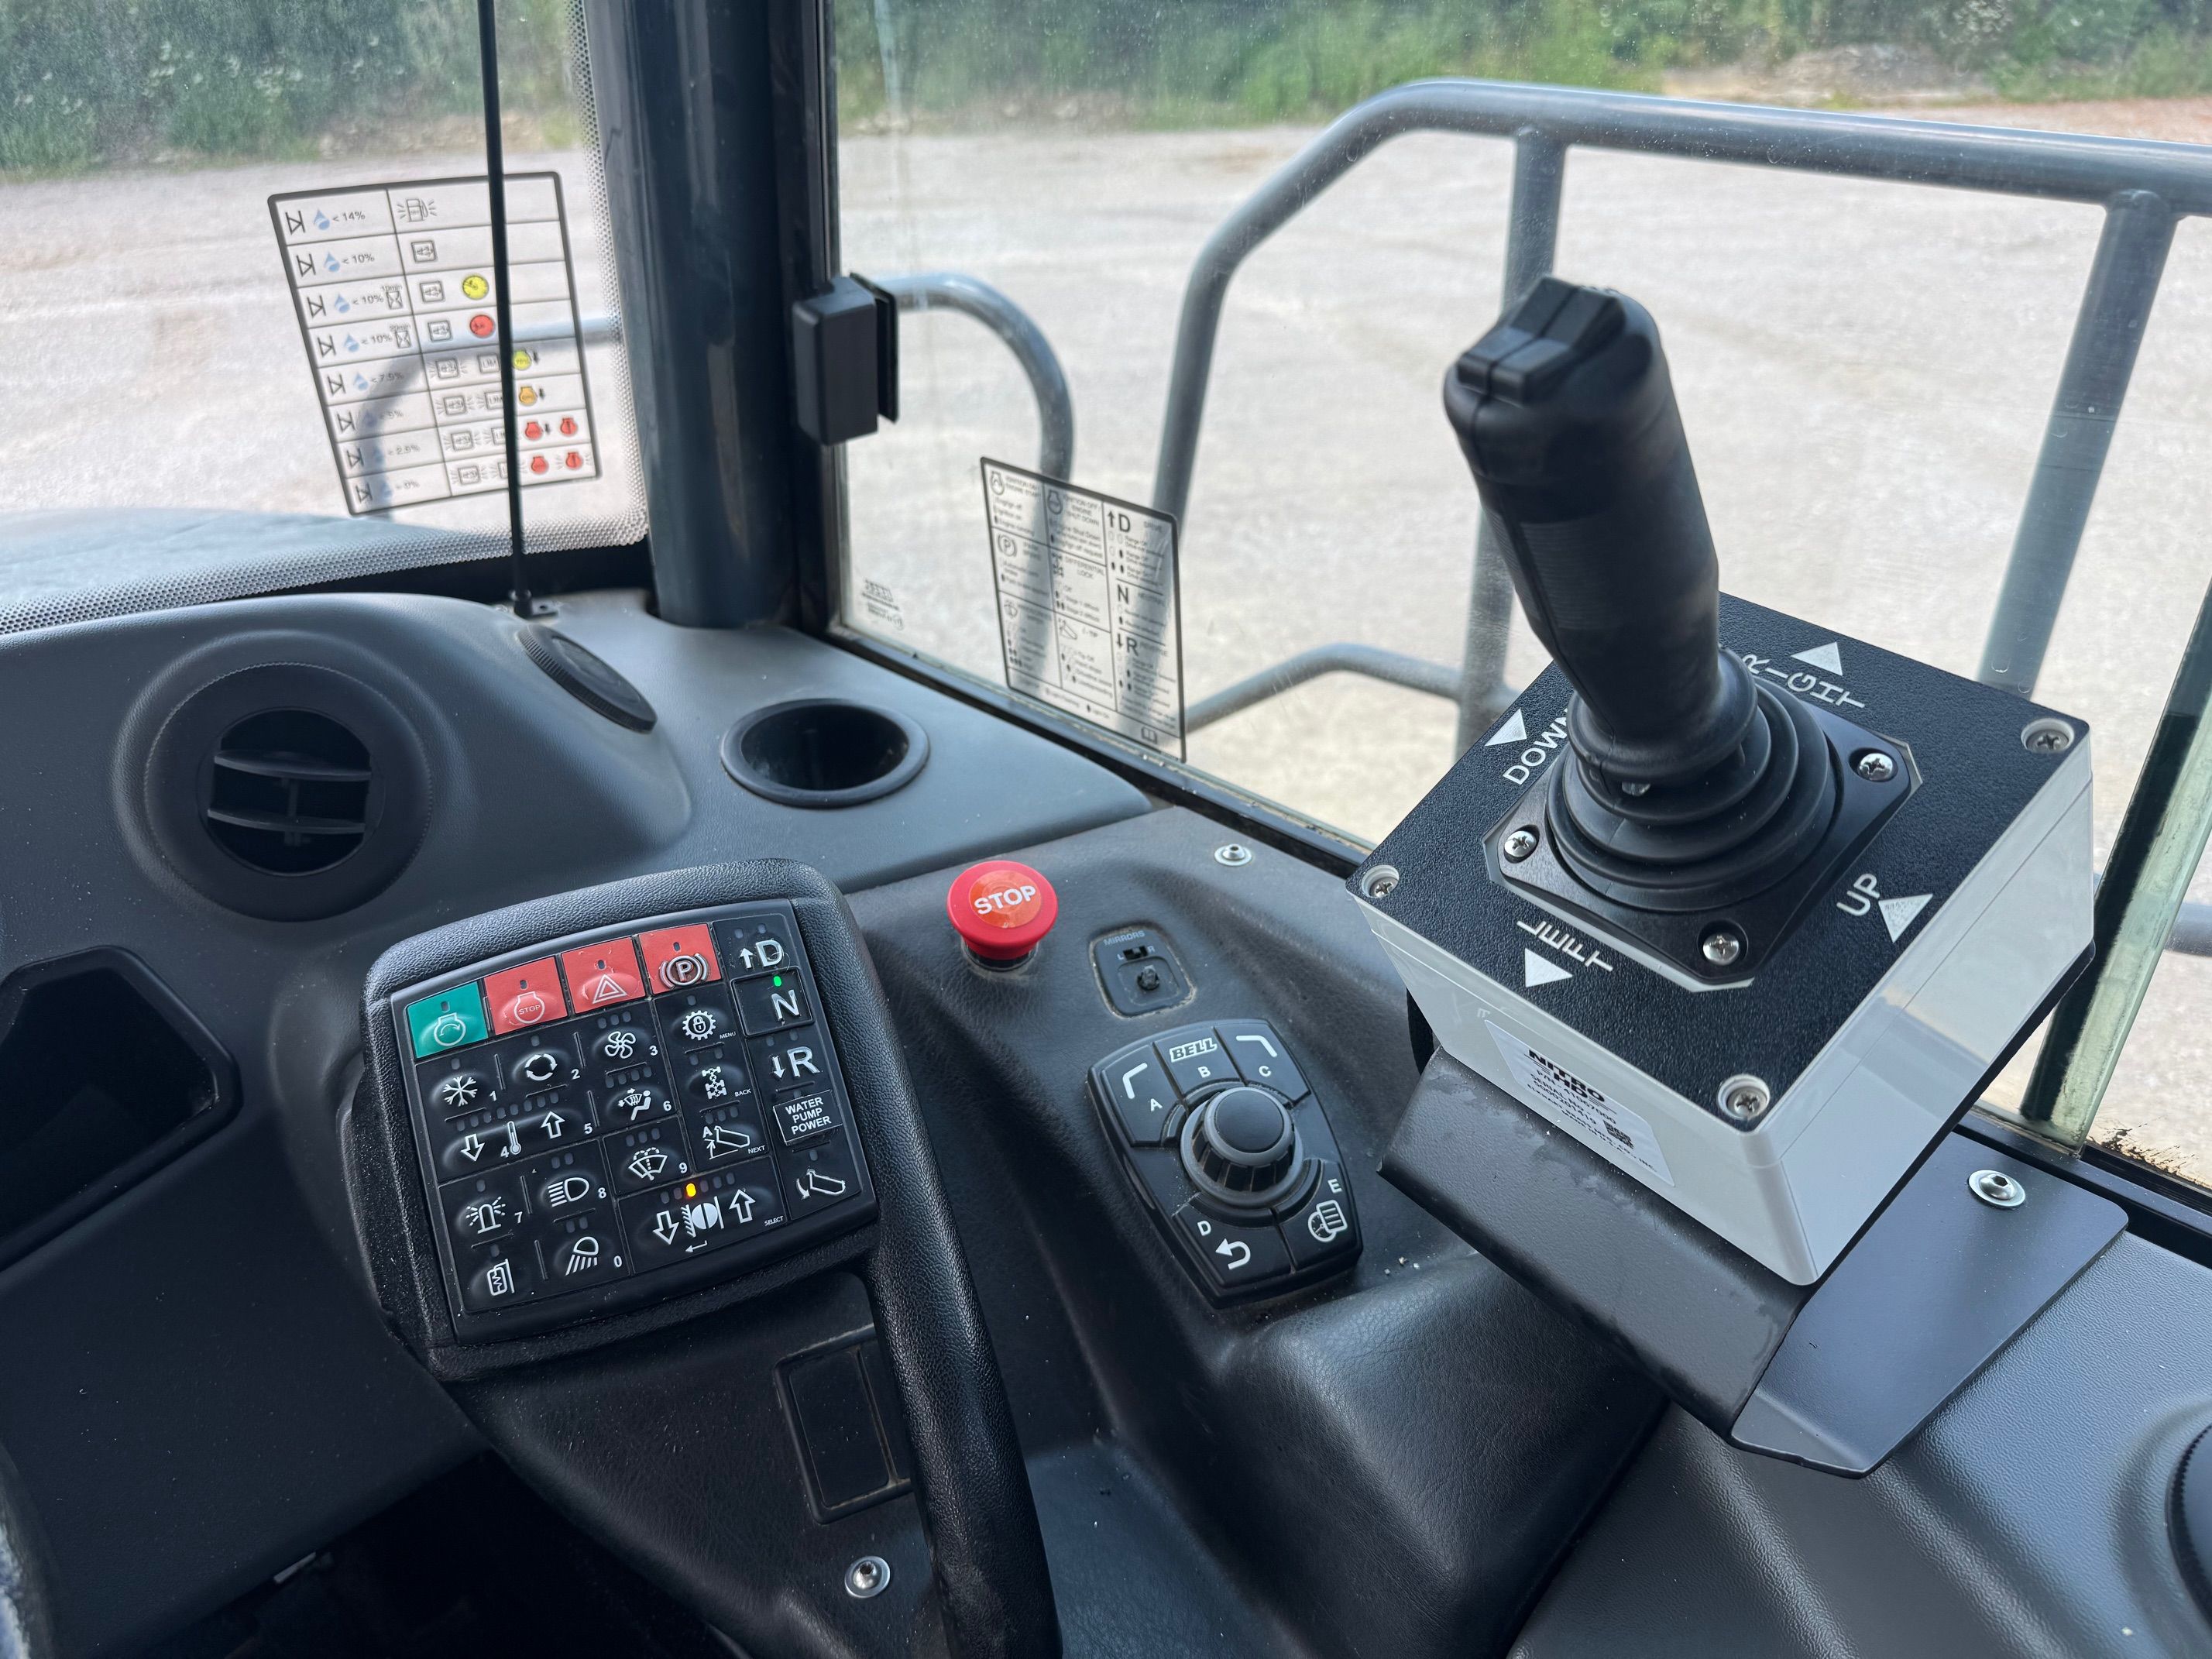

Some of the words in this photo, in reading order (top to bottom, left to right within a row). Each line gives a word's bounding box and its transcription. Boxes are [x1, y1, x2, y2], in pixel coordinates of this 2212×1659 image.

[342, 211, 366, 222] 14%
[352, 253, 375, 264] 10%
[362, 294, 384, 304] 10%
[1118, 514, 1131, 533] D
[1118, 585, 1128, 604] N
[1127, 637, 1139, 657] R
[1743, 654, 1865, 708] RIGHT
[974, 885, 1036, 915] STOP
[1836, 873, 1881, 916] UP
[1104, 930, 1146, 946] MIRRORS
[1516, 919, 1613, 972] LEFT
[755, 939, 784, 967] D
[518, 1004, 541, 1015] STOP
[771, 989, 800, 1021] N
[720, 1031, 737, 1040] MENU
[649, 1046, 658, 1056] 3
[1172, 1039, 1217, 1061] BELL
[787, 1046, 820, 1078] R
[571, 1069, 581, 1080] 2
[1198, 1066, 1211, 1078] B
[1259, 1066, 1271, 1077] C
[1529, 1049, 1606, 1103] NITRO
[734, 1088, 751, 1097] BACK
[1530, 1073, 1567, 1101] SERIAL
[1554, 1073, 1589, 1099] HD
[489, 1091, 497, 1101] 1
[663, 1101, 672, 1112] 6
[785, 1097, 824, 1115] WATER
[1150, 1098, 1163, 1111] A
[792, 1108, 823, 1124] PUMP
[584, 1123, 593, 1134] 5
[792, 1116, 832, 1135] POWER
[500, 1146, 509, 1159] 4
[747, 1145, 765, 1155] NEXT
[679, 1163, 688, 1174] 9
[1328, 1178, 1341, 1193] E
[598, 1187, 606, 1199] 8
[514, 1211, 523, 1223] 7
[764, 1215, 784, 1227] SELECT
[1197, 1221, 1211, 1235] D
[613, 1255, 623, 1268] 0
